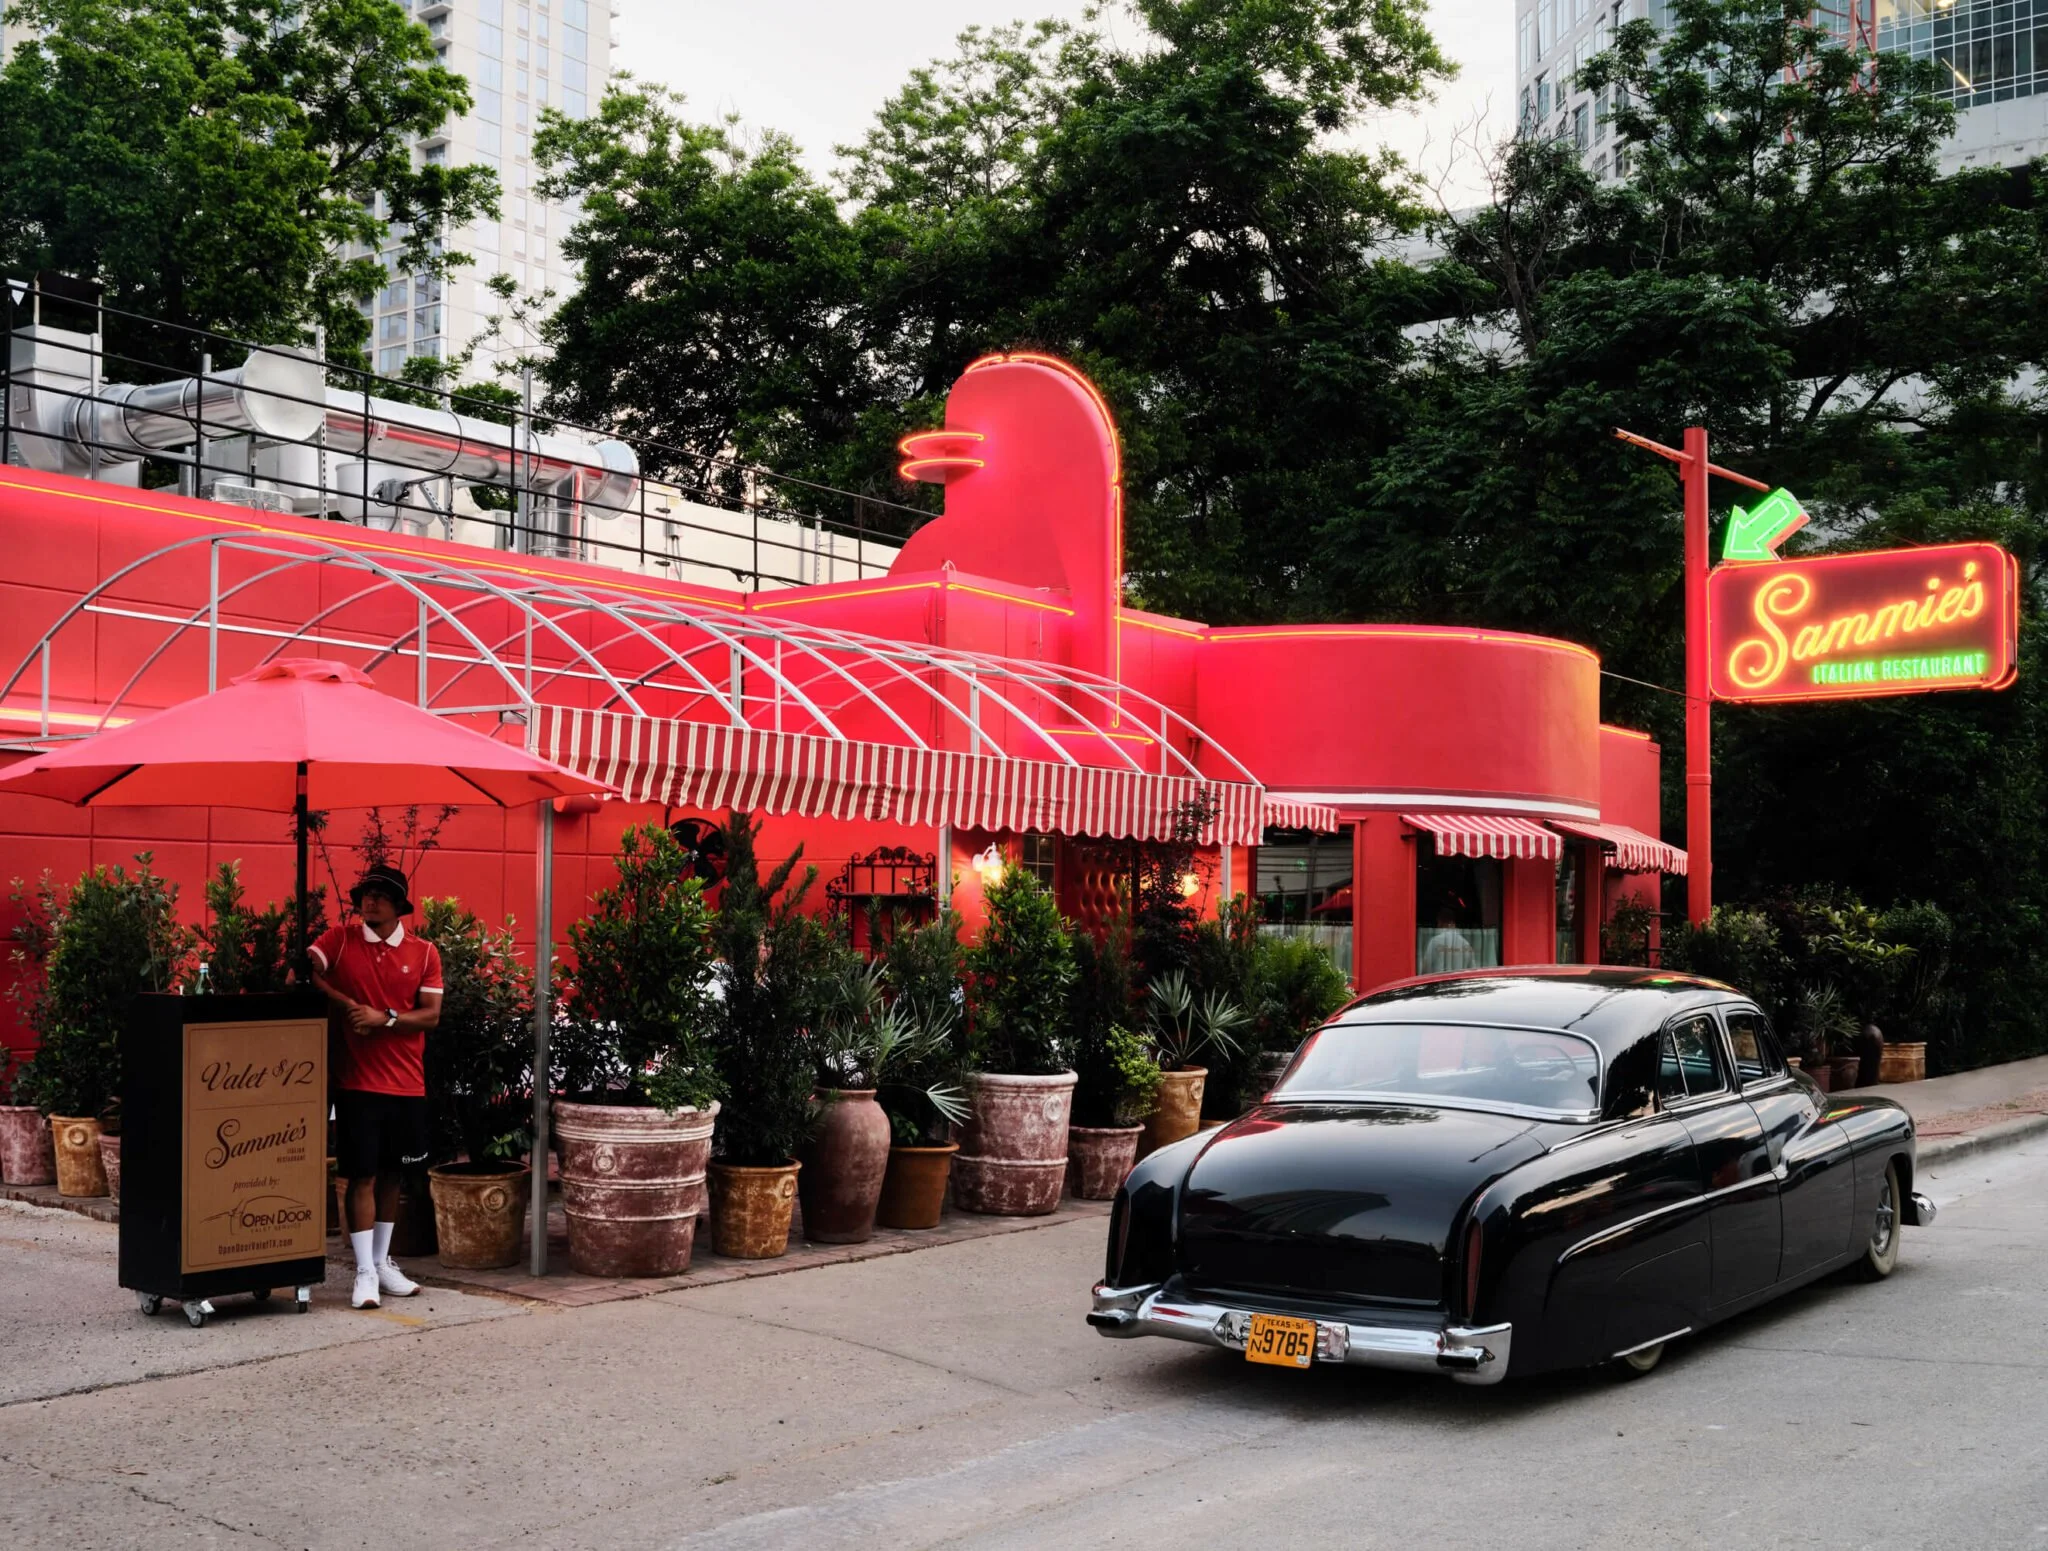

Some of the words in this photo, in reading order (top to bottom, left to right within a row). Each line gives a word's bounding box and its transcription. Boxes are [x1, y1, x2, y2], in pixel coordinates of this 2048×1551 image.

[1728, 561, 1985, 688] Sammie's
[1812, 662, 1877, 685] ITALIAN
[1881, 653, 1986, 681] RESTAURANT
[201, 1061, 268, 1092] Valet
[272, 1059, 315, 1087] $12
[204, 1117, 307, 1170] Sammie's
[232, 1176, 267, 1193] provided
[268, 1175, 280, 1190] by:
[241, 1212, 276, 1228] OPEN
[277, 1208, 312, 1225] DOOR
[1262, 1329, 1309, 1356] 9785
